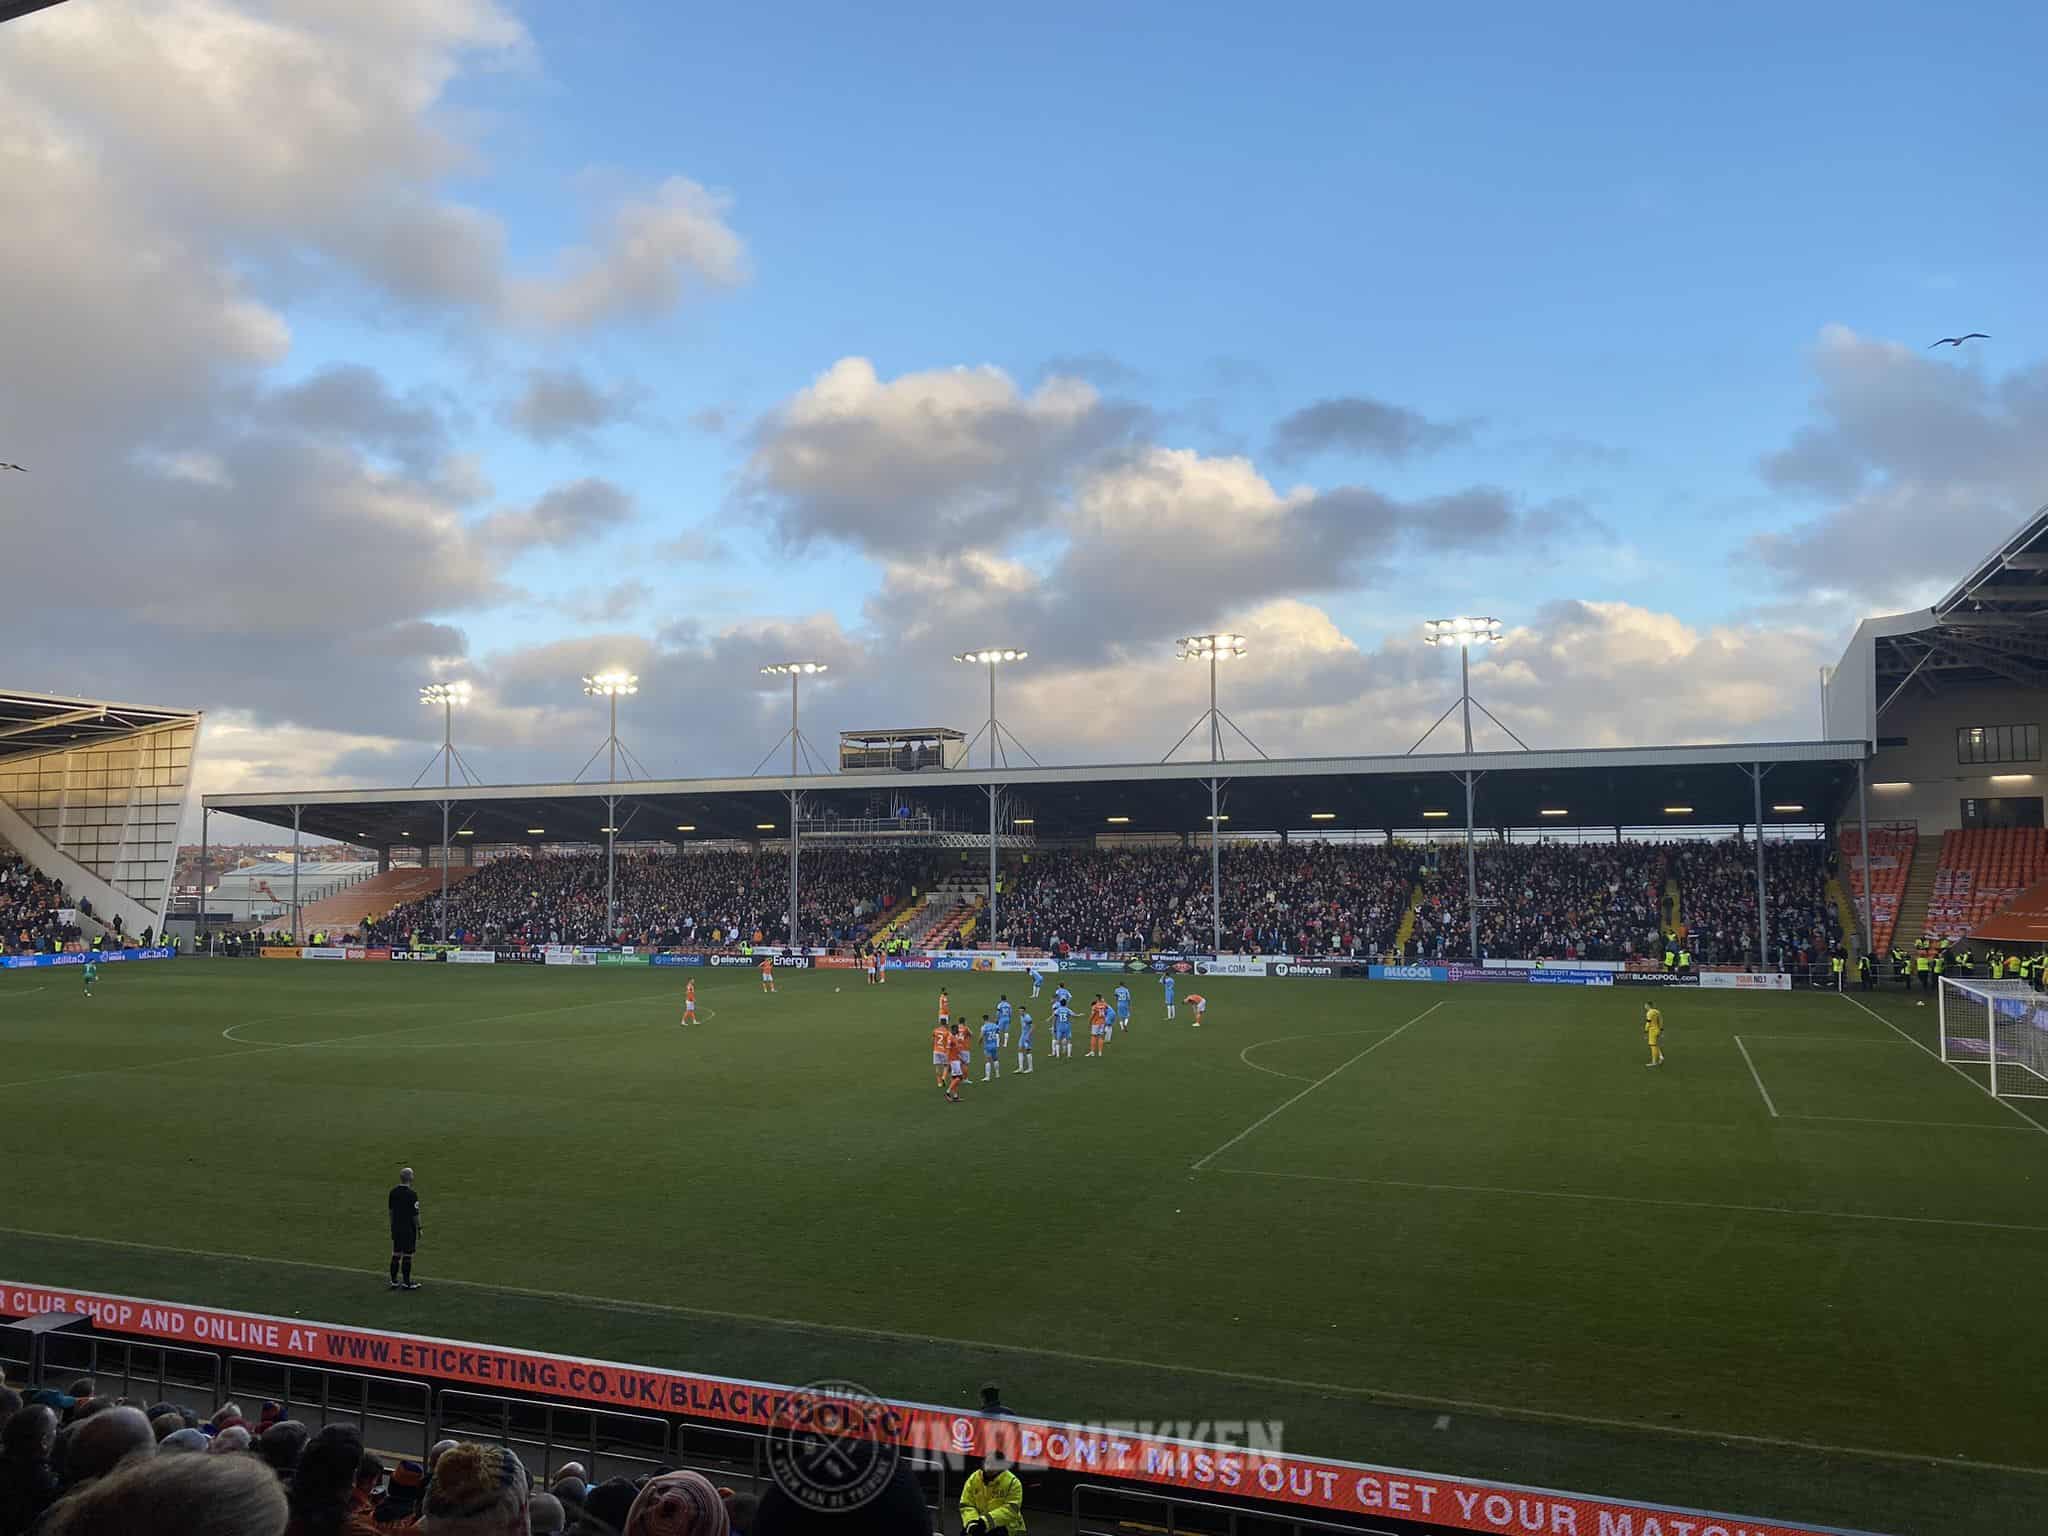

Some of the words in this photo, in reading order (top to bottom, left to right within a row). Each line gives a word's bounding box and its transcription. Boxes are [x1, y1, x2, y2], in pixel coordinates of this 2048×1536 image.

[774, 956, 808, 968] Energy
[1289, 964, 1331, 974] eleven
[13, 1291, 66, 1314] CLUB
[74, 1299, 132, 1326] SHOP
[140, 1308, 186, 1333] AND
[194, 1316, 279, 1348] ONLINE
[288, 1329, 318, 1353] AT
[1021, 1430, 1132, 1468] DON'T
[1147, 1447, 1242, 1487] MISS
[1258, 1463, 1338, 1501] OUT
[1356, 1477, 1438, 1515] GET
[1454, 1489, 1578, 1536] YOUR
